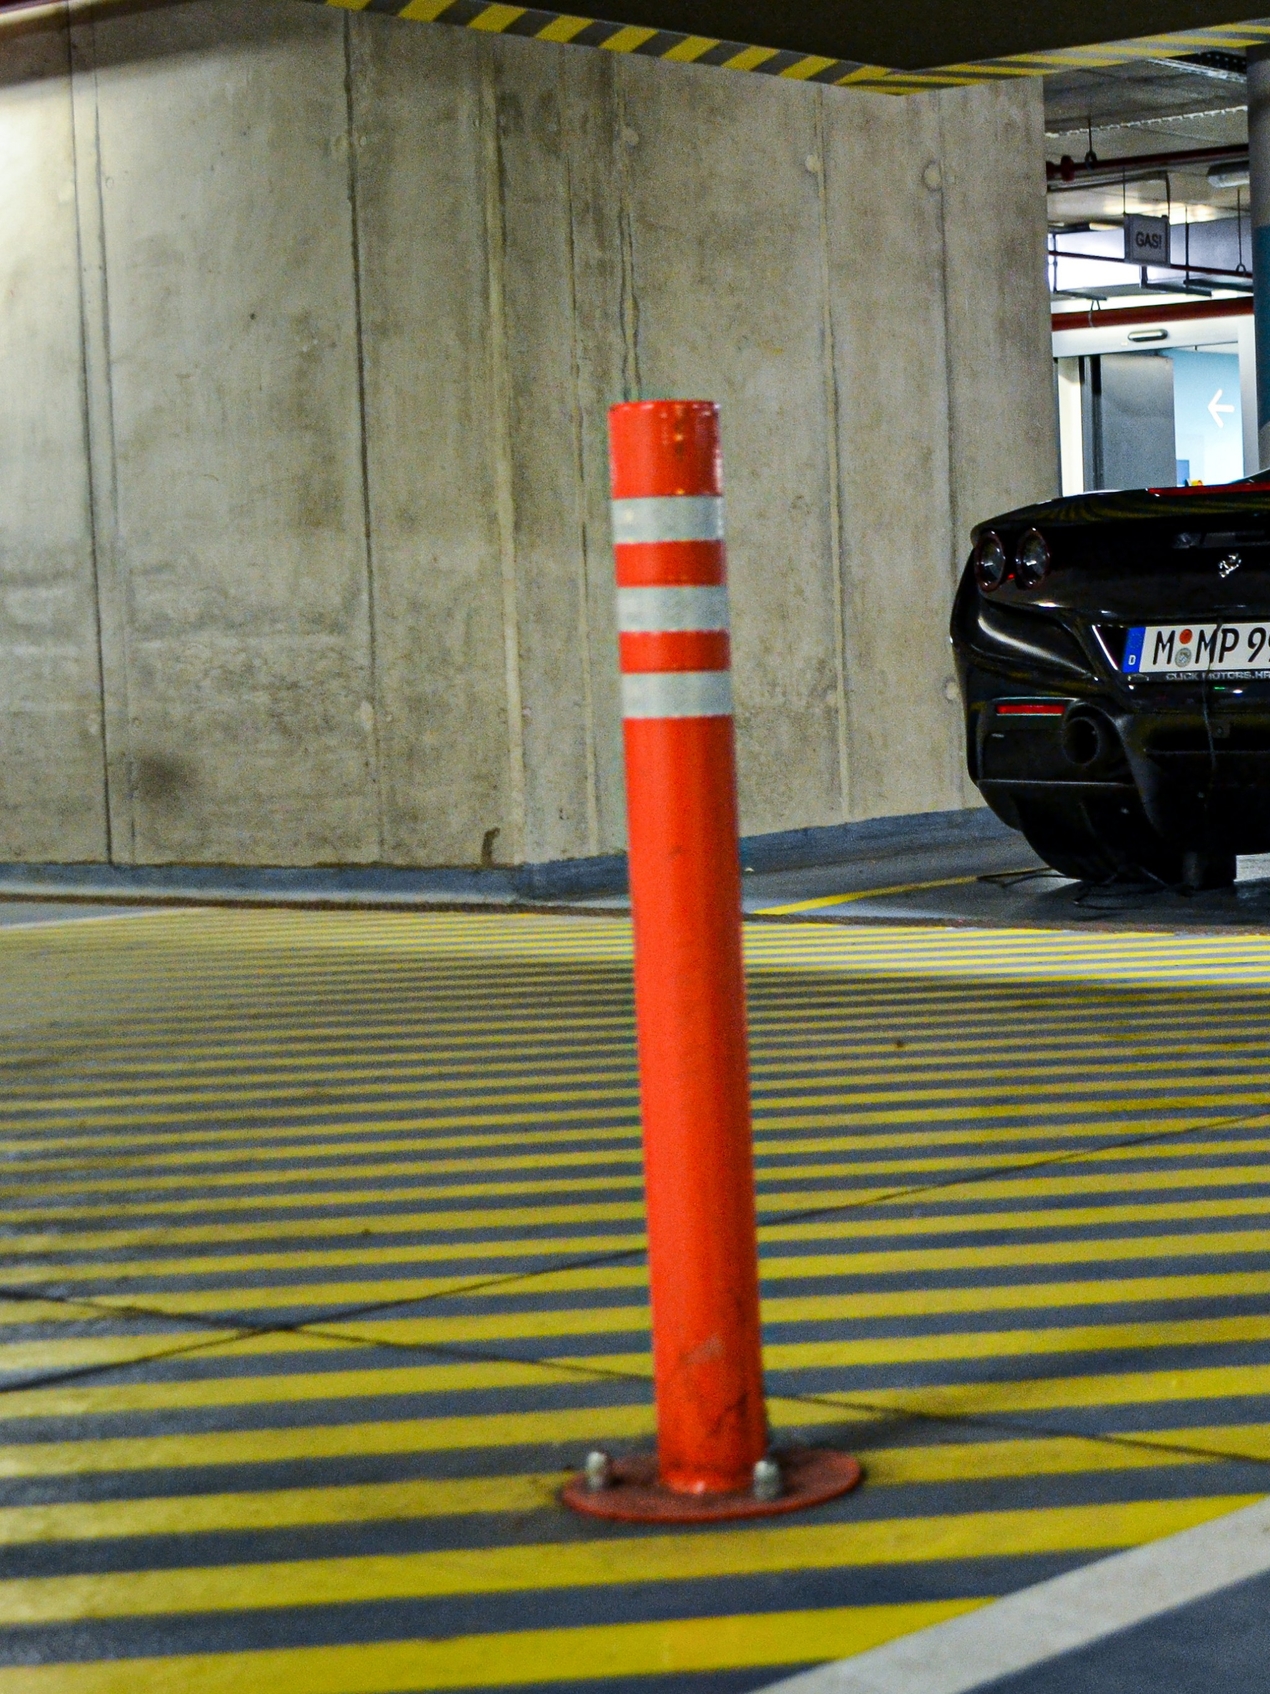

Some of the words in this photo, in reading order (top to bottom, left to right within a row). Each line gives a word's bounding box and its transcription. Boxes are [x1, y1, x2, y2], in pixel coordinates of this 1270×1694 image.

[1152, 630, 1176, 665] M
[1195, 628, 1240, 664] MP
[1128, 654, 1136, 666] D
[1165, 672, 1199, 681] CLICK
